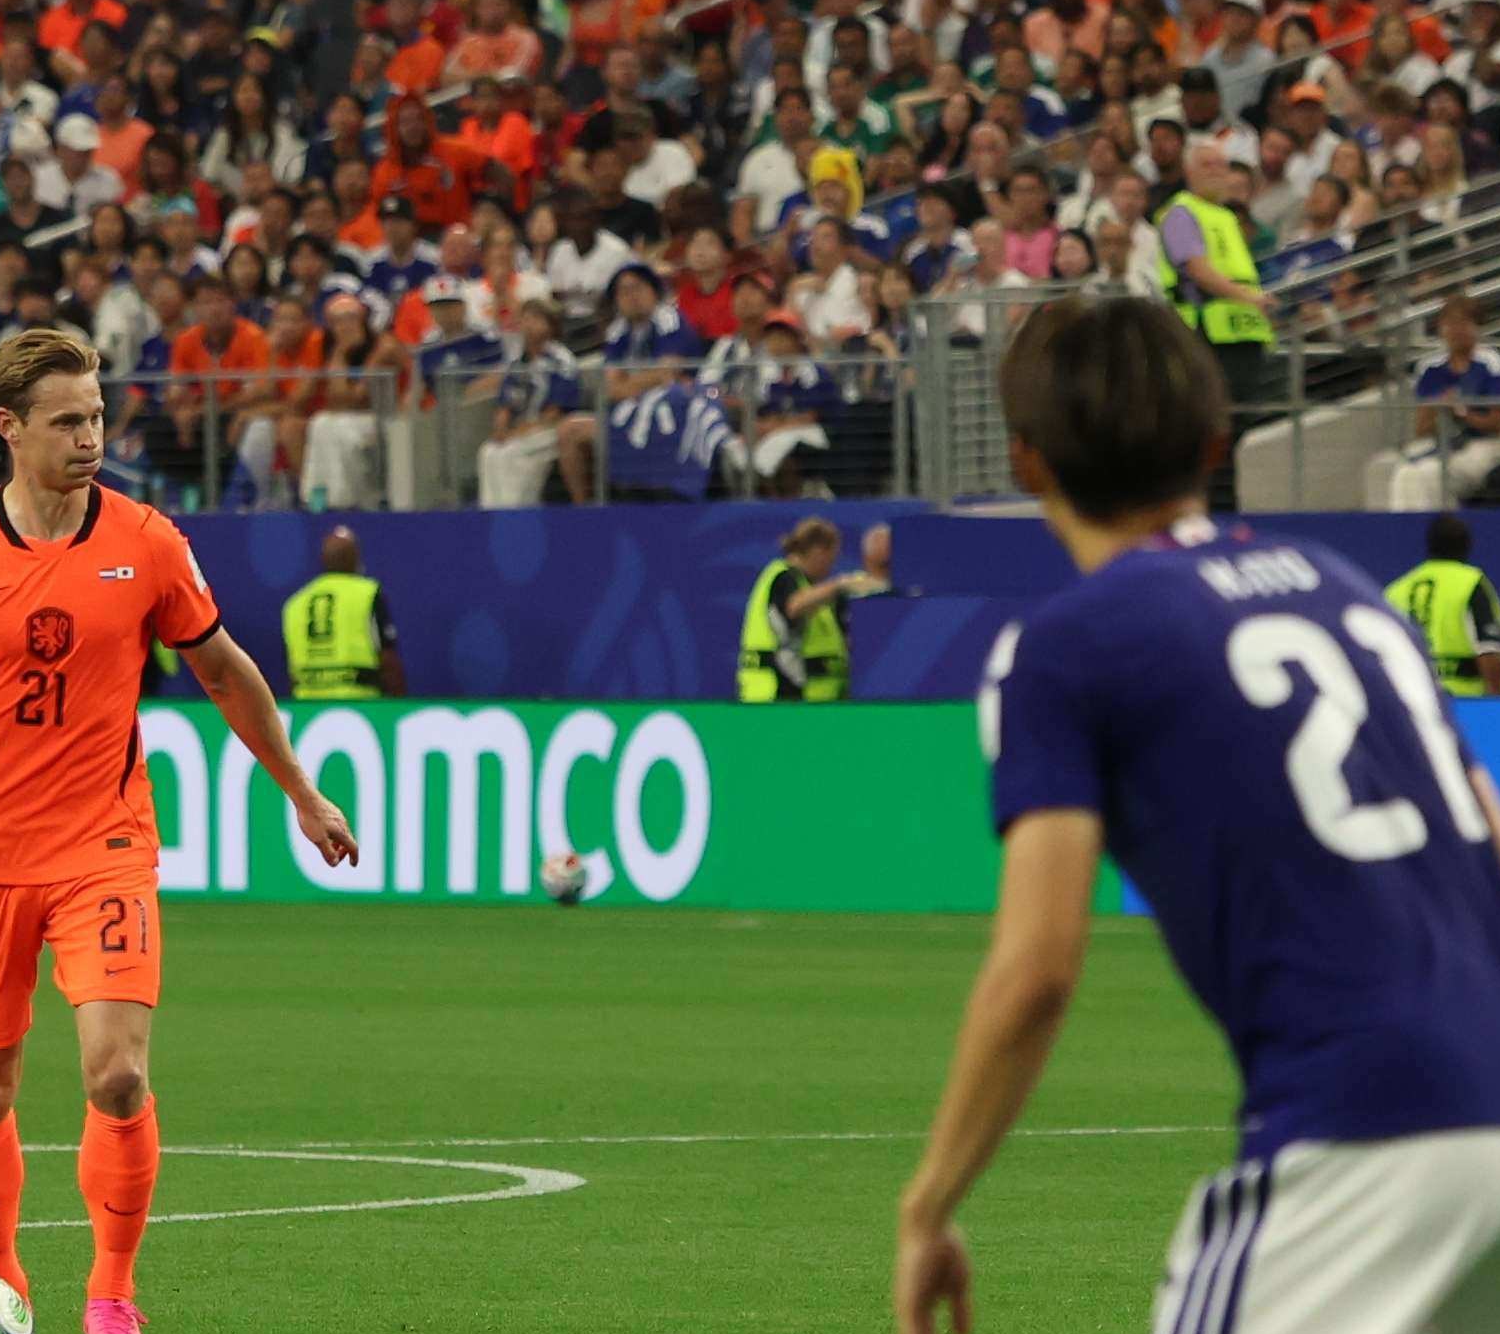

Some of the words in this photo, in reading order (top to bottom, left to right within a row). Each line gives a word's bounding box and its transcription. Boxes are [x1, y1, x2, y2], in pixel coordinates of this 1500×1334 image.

[16, 670, 66, 727] 21
[1226, 604, 1490, 862] 21
[139, 707, 711, 902] aramco
[99, 897, 147, 955] 21
